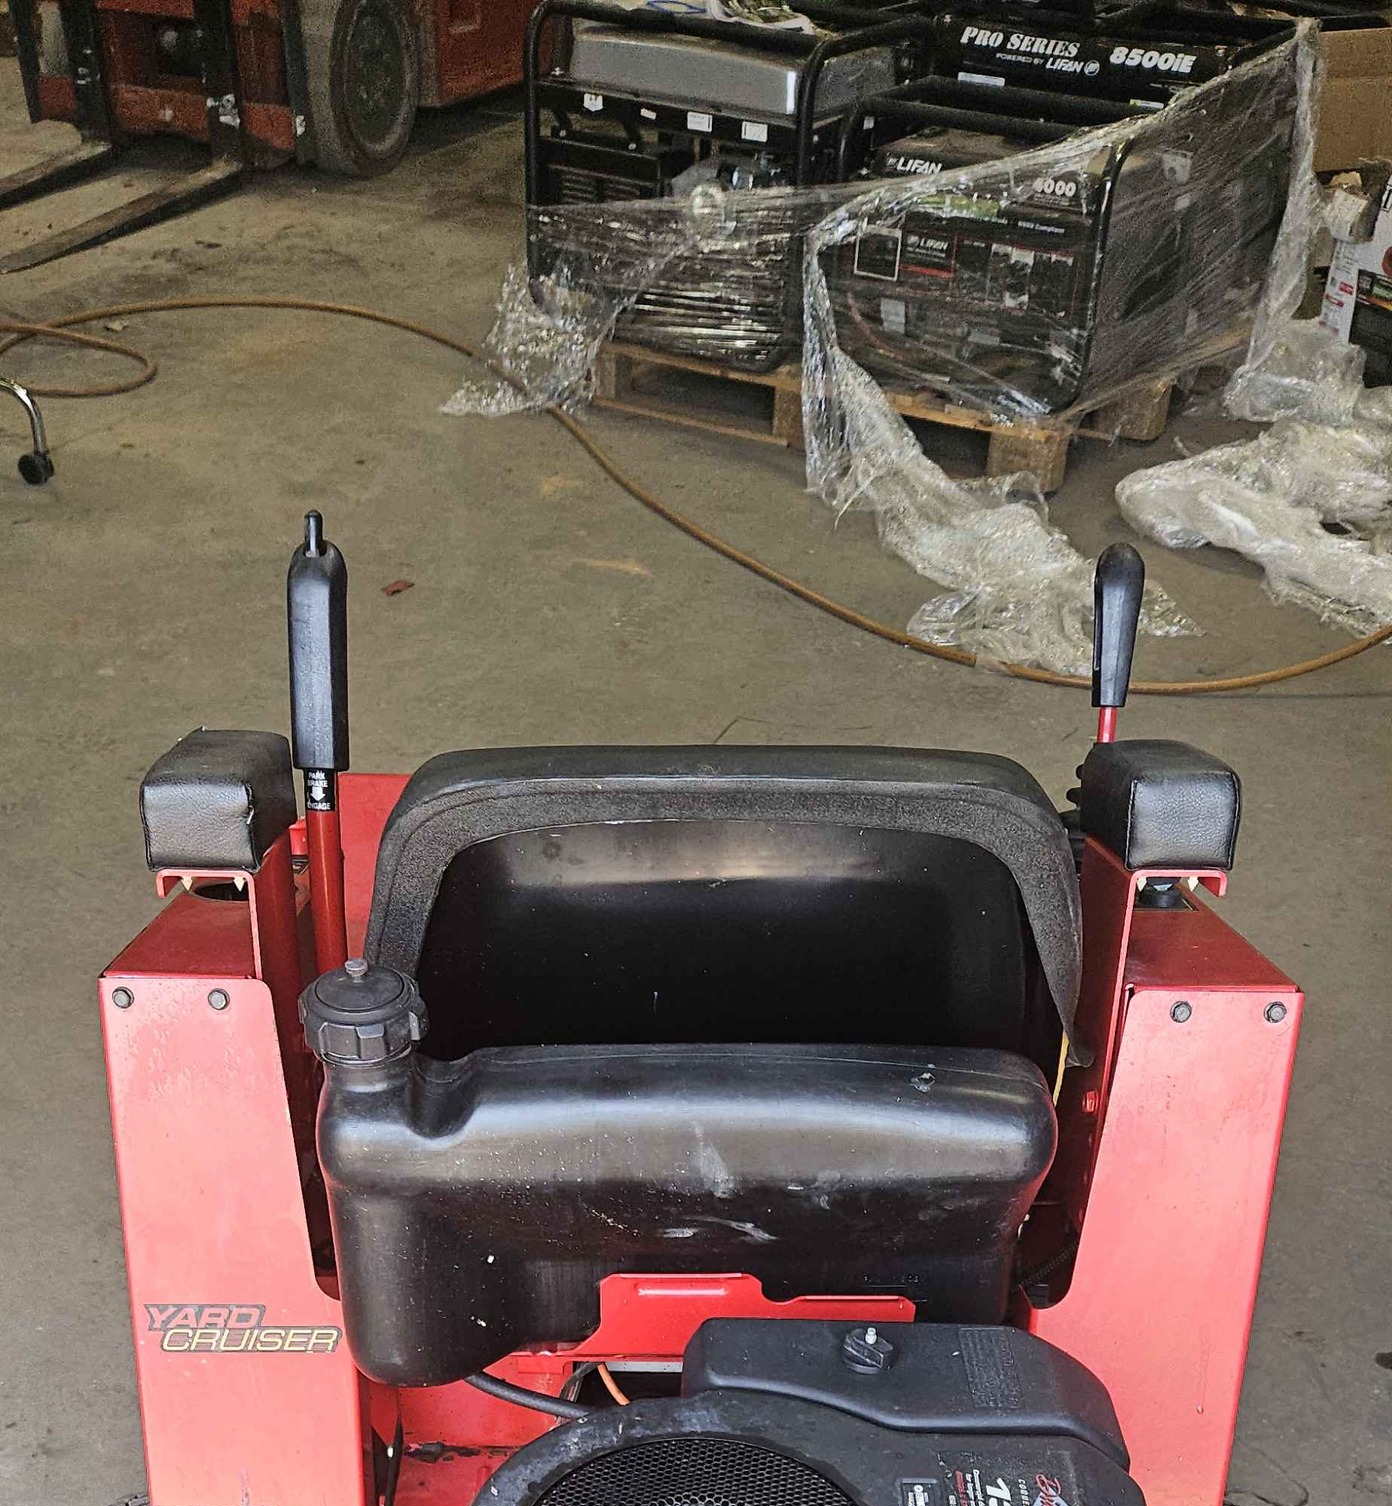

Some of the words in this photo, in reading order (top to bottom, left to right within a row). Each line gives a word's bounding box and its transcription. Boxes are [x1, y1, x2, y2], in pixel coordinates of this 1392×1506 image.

[960, 26, 1004, 47] PRO
[1006, 33, 1080, 58] SERIES
[996, 53, 1033, 63] POWERED
[1033, 57, 1044, 65] BY
[1045, 57, 1085, 74] LIFAN
[1109, 46, 1198, 74] 8500iE
[896, 156, 943, 175] LIFAN
[307, 779, 329, 788] BRAKE
[308, 771, 326, 780] PARK
[148, 1306, 262, 1329] YARD
[162, 1328, 339, 1351] CRUISER
